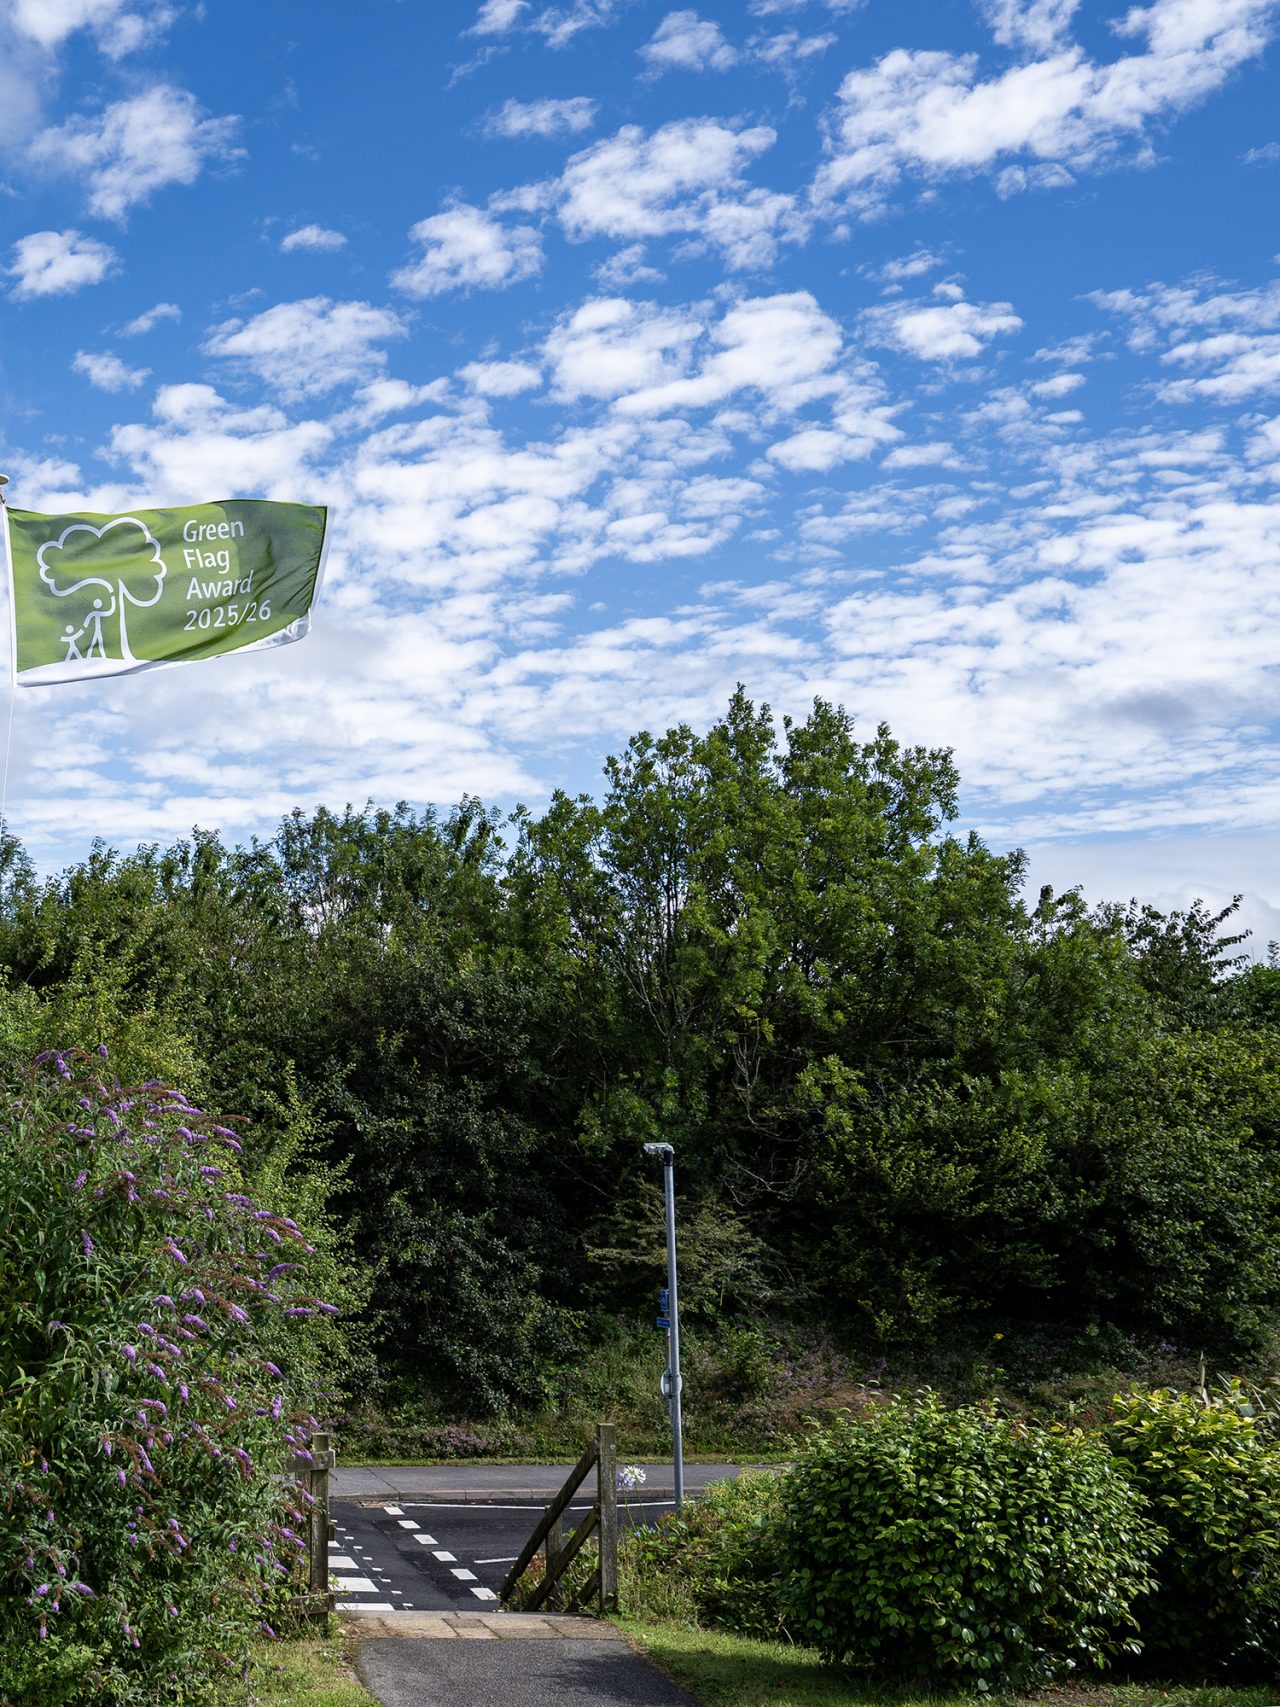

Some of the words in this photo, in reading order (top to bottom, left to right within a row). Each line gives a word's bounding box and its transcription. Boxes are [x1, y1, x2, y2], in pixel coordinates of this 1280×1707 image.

[183, 519, 245, 543] Green
[183, 549, 230, 574] Flag
[186, 570, 254, 600] Award
[184, 600, 271, 631] 2025/26
